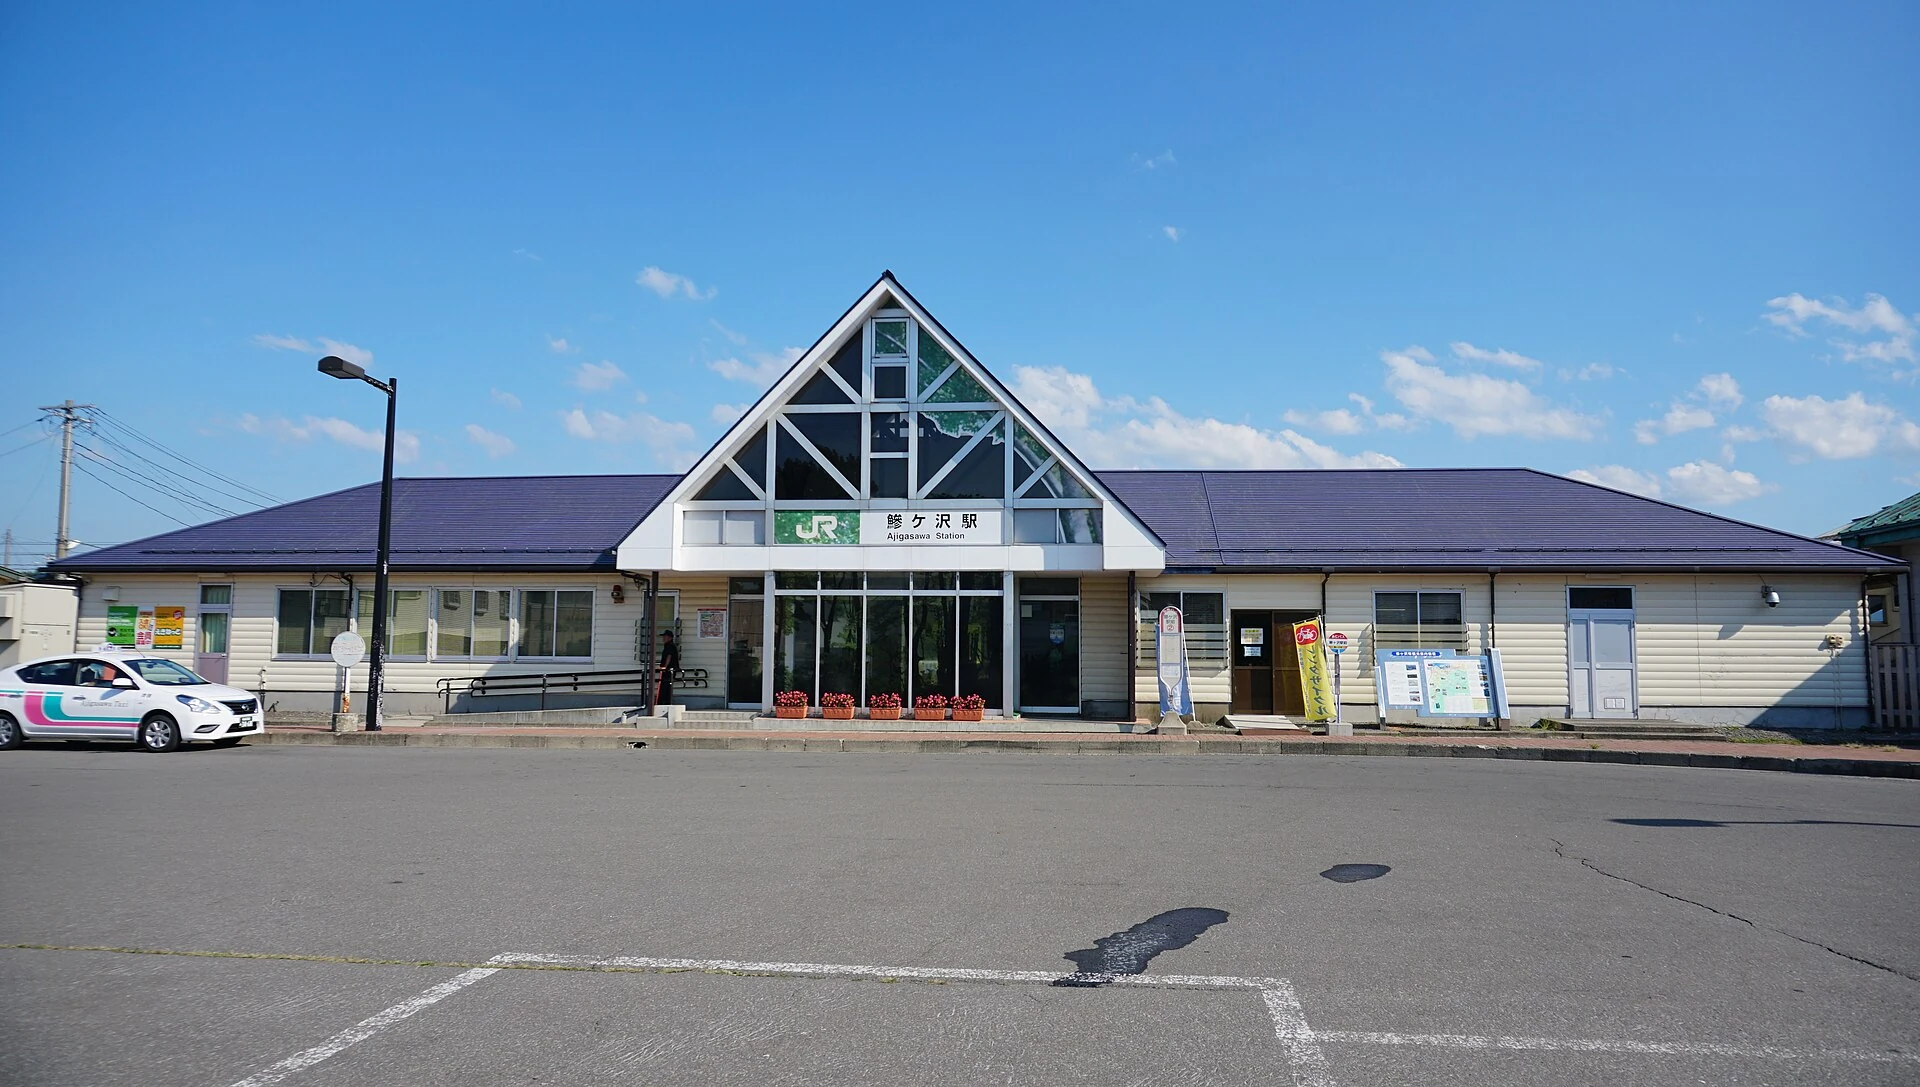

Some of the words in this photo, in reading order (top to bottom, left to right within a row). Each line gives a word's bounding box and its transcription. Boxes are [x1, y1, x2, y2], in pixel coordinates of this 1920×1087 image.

[796, 515, 838, 539] JR
[887, 532, 931, 542] Ajigasawa
[935, 532, 965, 540] Station
